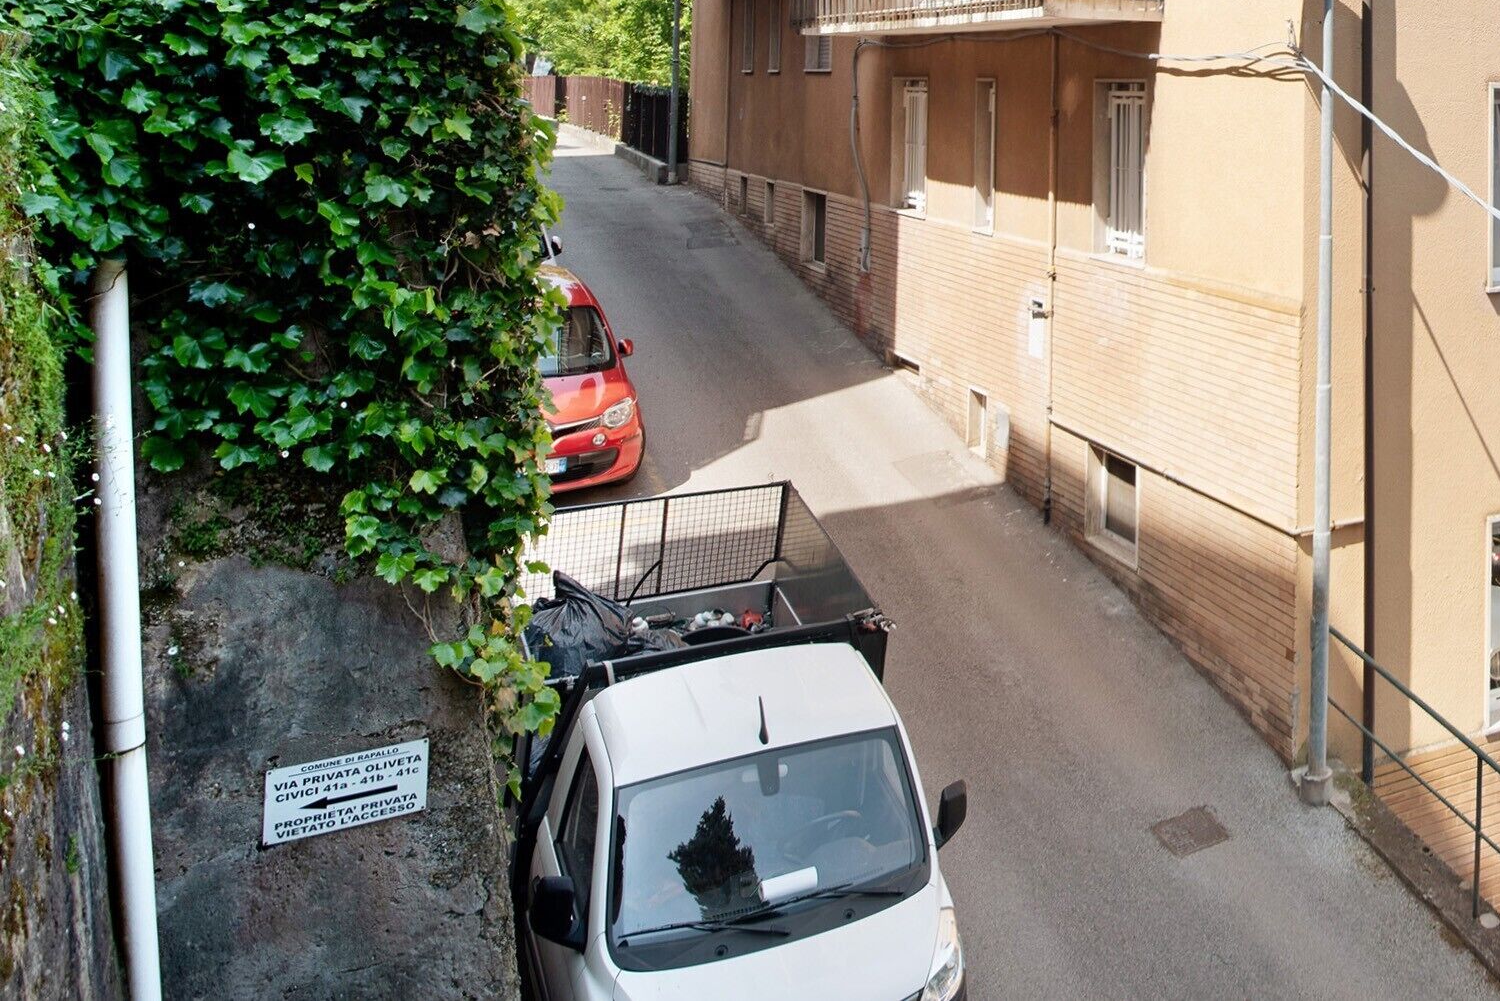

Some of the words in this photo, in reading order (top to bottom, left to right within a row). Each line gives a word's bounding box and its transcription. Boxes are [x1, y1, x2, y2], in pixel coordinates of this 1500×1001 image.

[274, 779, 298, 793] VIA
[302, 767, 361, 787] PRIVATA
[365, 754, 422, 773] OLIVETA
[300, 760, 343, 772] COMUNE
[345, 756, 355, 764] DI
[357, 747, 399, 763] RAPALLO
[275, 787, 319, 803] CIVICI
[323, 782, 348, 794] 41a
[360, 772, 384, 785] 41b
[396, 767, 419, 779] 41c
[274, 805, 357, 831] PROPRIETA'
[363, 792, 418, 811] PRIVATA
[276, 820, 336, 840] VIETATO
[340, 801, 415, 825] L'ACCESSO
